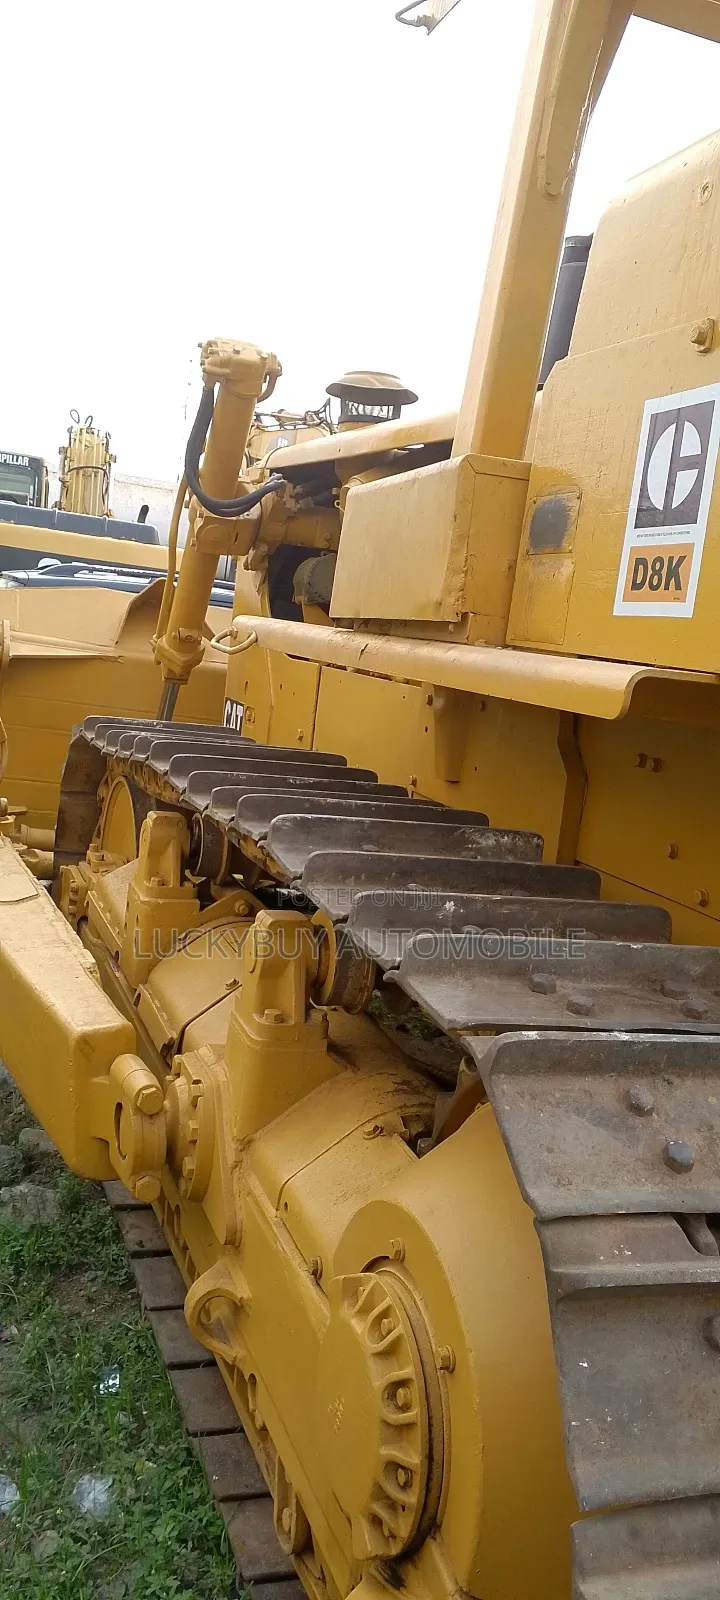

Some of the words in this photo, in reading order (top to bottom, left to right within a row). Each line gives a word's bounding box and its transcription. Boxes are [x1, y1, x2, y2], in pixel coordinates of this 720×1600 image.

[0, 453, 29, 467] PILLAR
[631, 555, 687, 592] D8K
[224, 700, 243, 731] CAT
